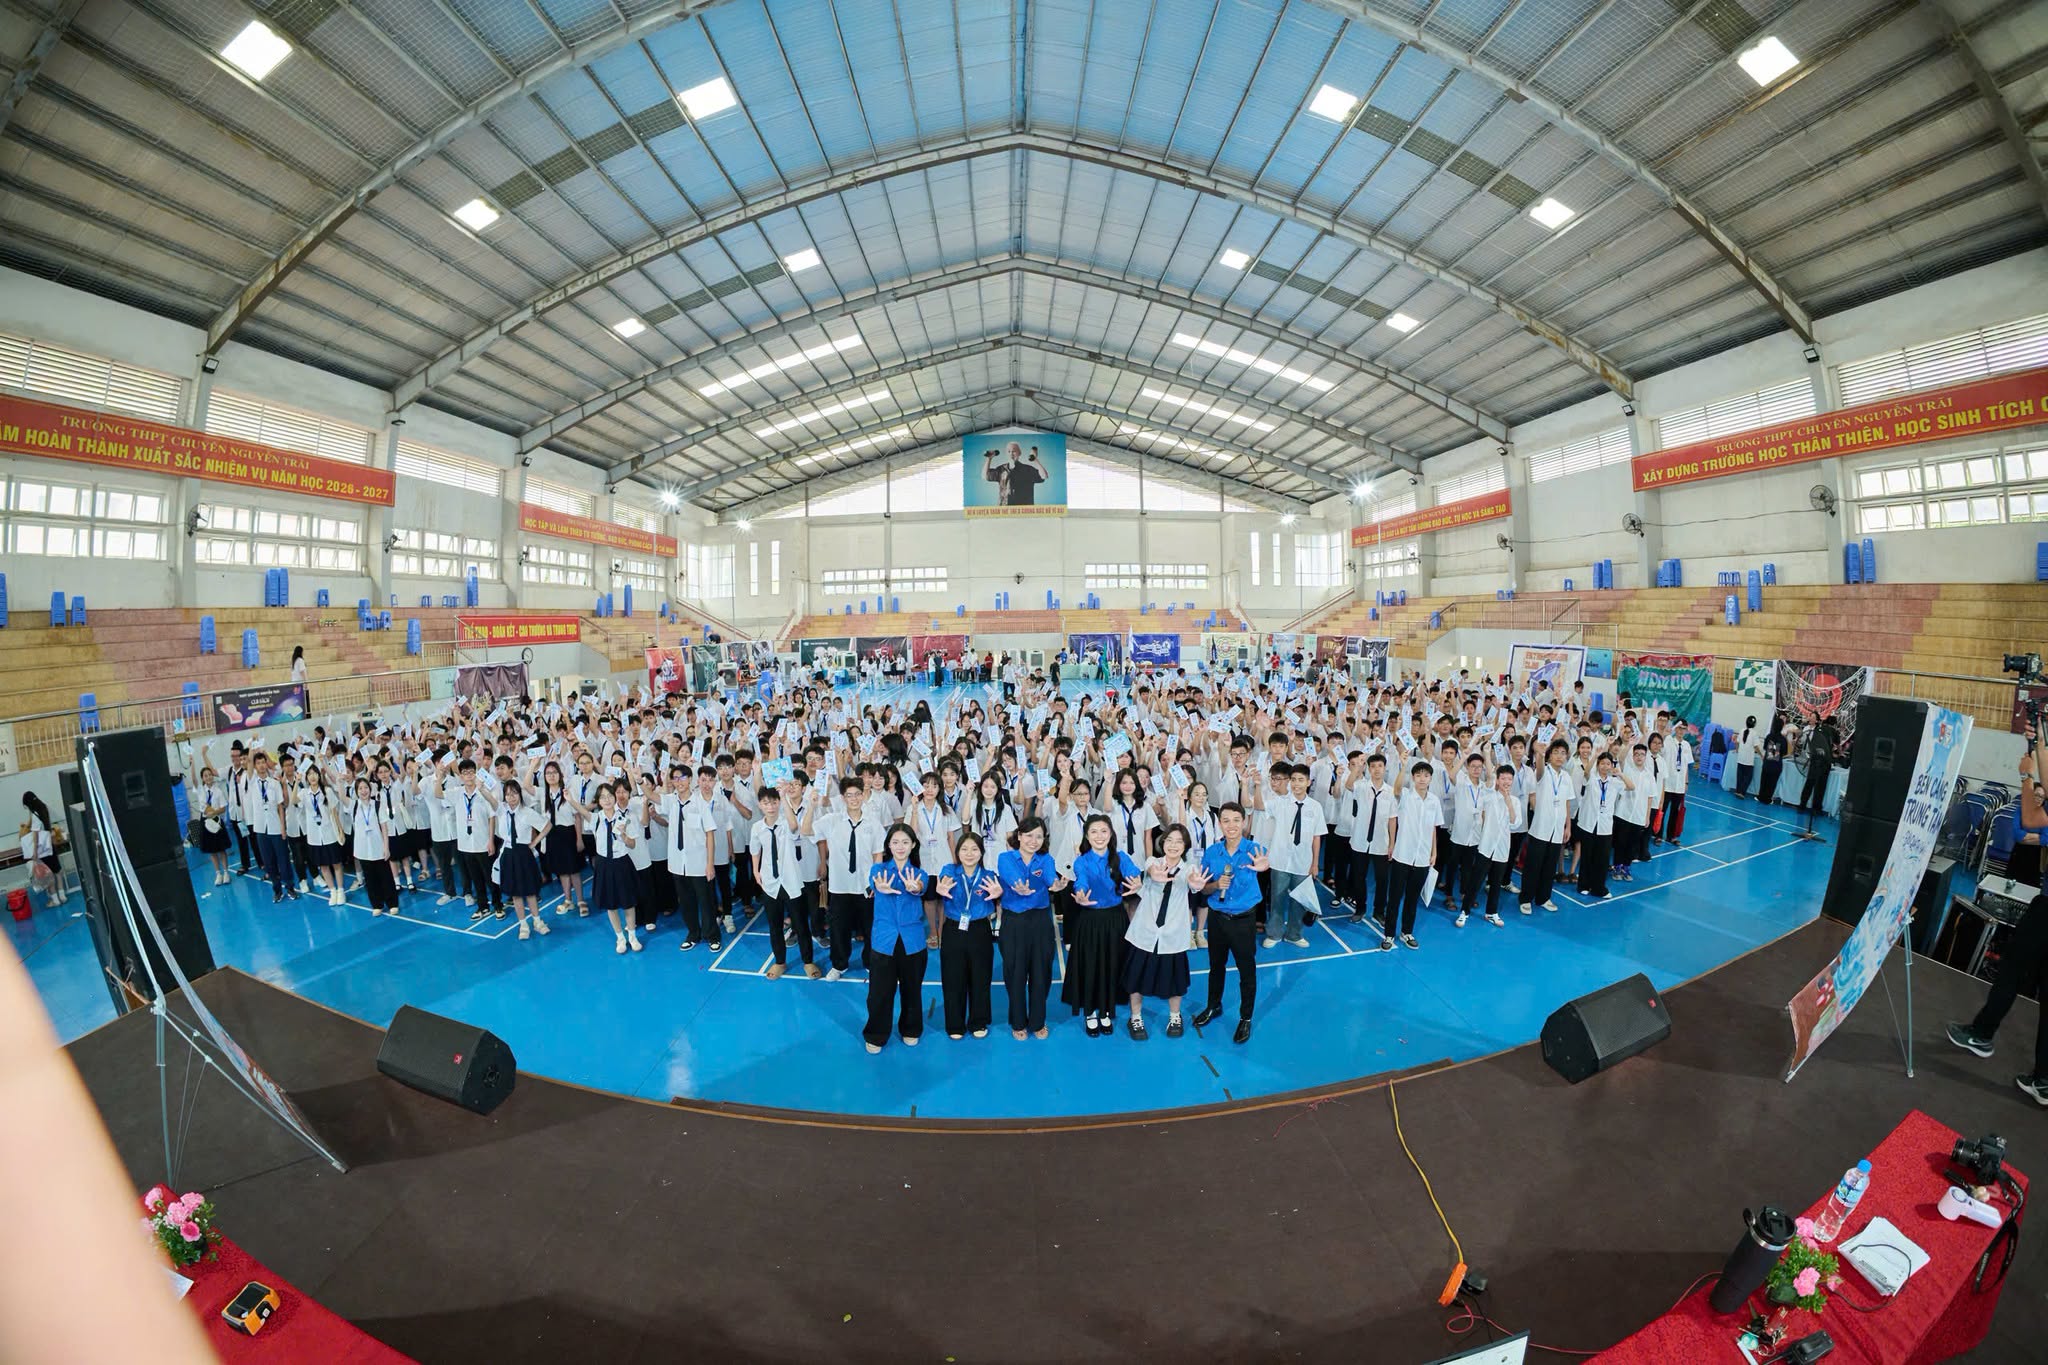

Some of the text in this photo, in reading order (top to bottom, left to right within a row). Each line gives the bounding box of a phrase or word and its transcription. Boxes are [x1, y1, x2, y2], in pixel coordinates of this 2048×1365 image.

[1762, 430, 1794, 443] THPT
[1797, 415, 1850, 437] CHUYÊN
[1853, 404, 1914, 425] NGUYỄN
[1916, 396, 1953, 413] TRÃI
[130, 427, 168, 443] THPT
[171, 434, 227, 454] CHUYÊN
[1642, 468, 1664, 483] XÂY
[1667, 462, 1699, 480] DỰNG
[1702, 452, 1755, 472] TRƯỜNG
[1758, 447, 1788, 463] HỌC
[1792, 436, 1831, 455] THÂN
[1836, 426, 1890, 446] THIỆN,
[1894, 418, 1931, 438] HỌC
[1937, 409, 1982, 430] SINH
[1987, 399, 2034, 421] TÍCH
[25, 428, 72, 450] HOÀN
[77, 436, 129, 459] THÀNH
[133, 444, 171, 465] XUẤT
[174, 450, 201, 470] SẮC
[205, 458, 247, 480] NHIỆM
[251, 468, 267, 483] VỤ
[271, 469, 297, 485] NĂM
[300, 476, 324, 491] HỌC
[362, 486, 389, 500] 2027
[1914, 765, 1932, 795] BẾN
[1904, 799, 1931, 829] TRUNG
